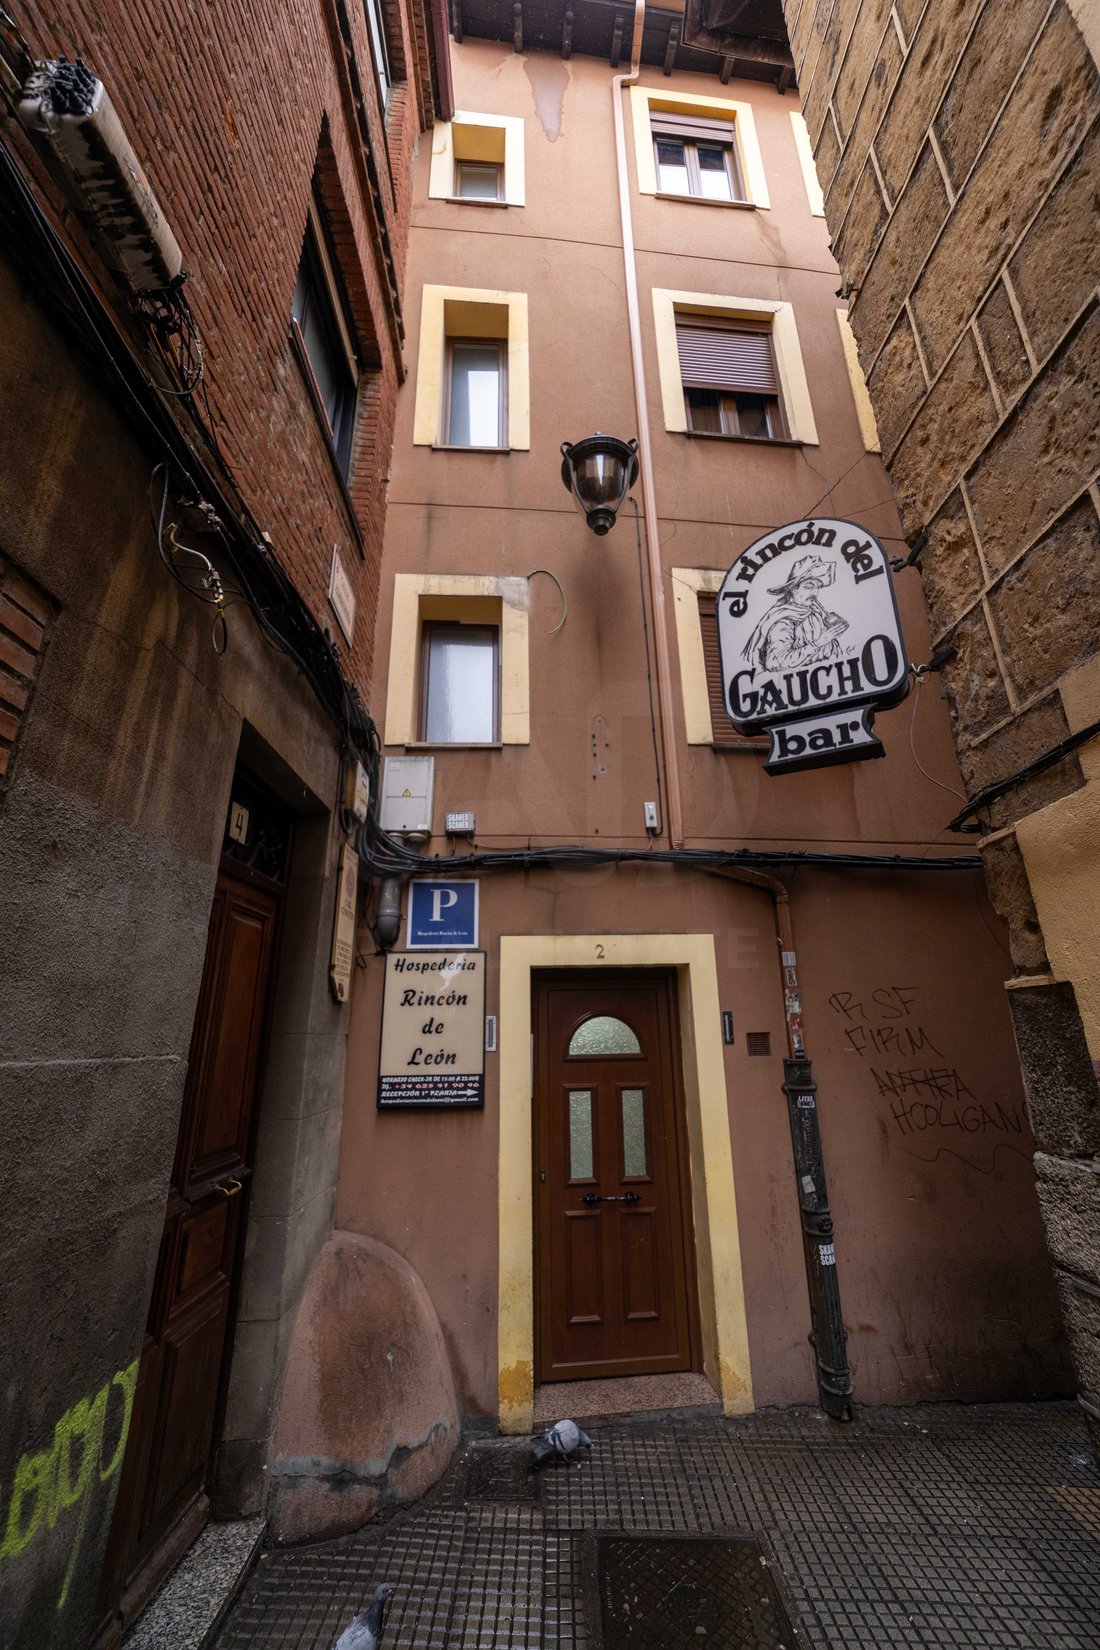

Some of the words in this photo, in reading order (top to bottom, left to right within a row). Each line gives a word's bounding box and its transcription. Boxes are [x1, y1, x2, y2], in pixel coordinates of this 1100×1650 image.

[722, 589, 749, 618] el
[736, 521, 837, 584] rincón
[840, 538, 885, 584] del
[728, 634, 899, 718] GAUCHO
[775, 720, 860, 759] bar
[235, 813, 243, 835] 4
[429, 889, 458, 922] P
[595, 944, 605, 959] 2
[401, 989, 468, 1007] Rincón
[422, 1017, 445, 1034] de
[407, 1048, 457, 1066] León
